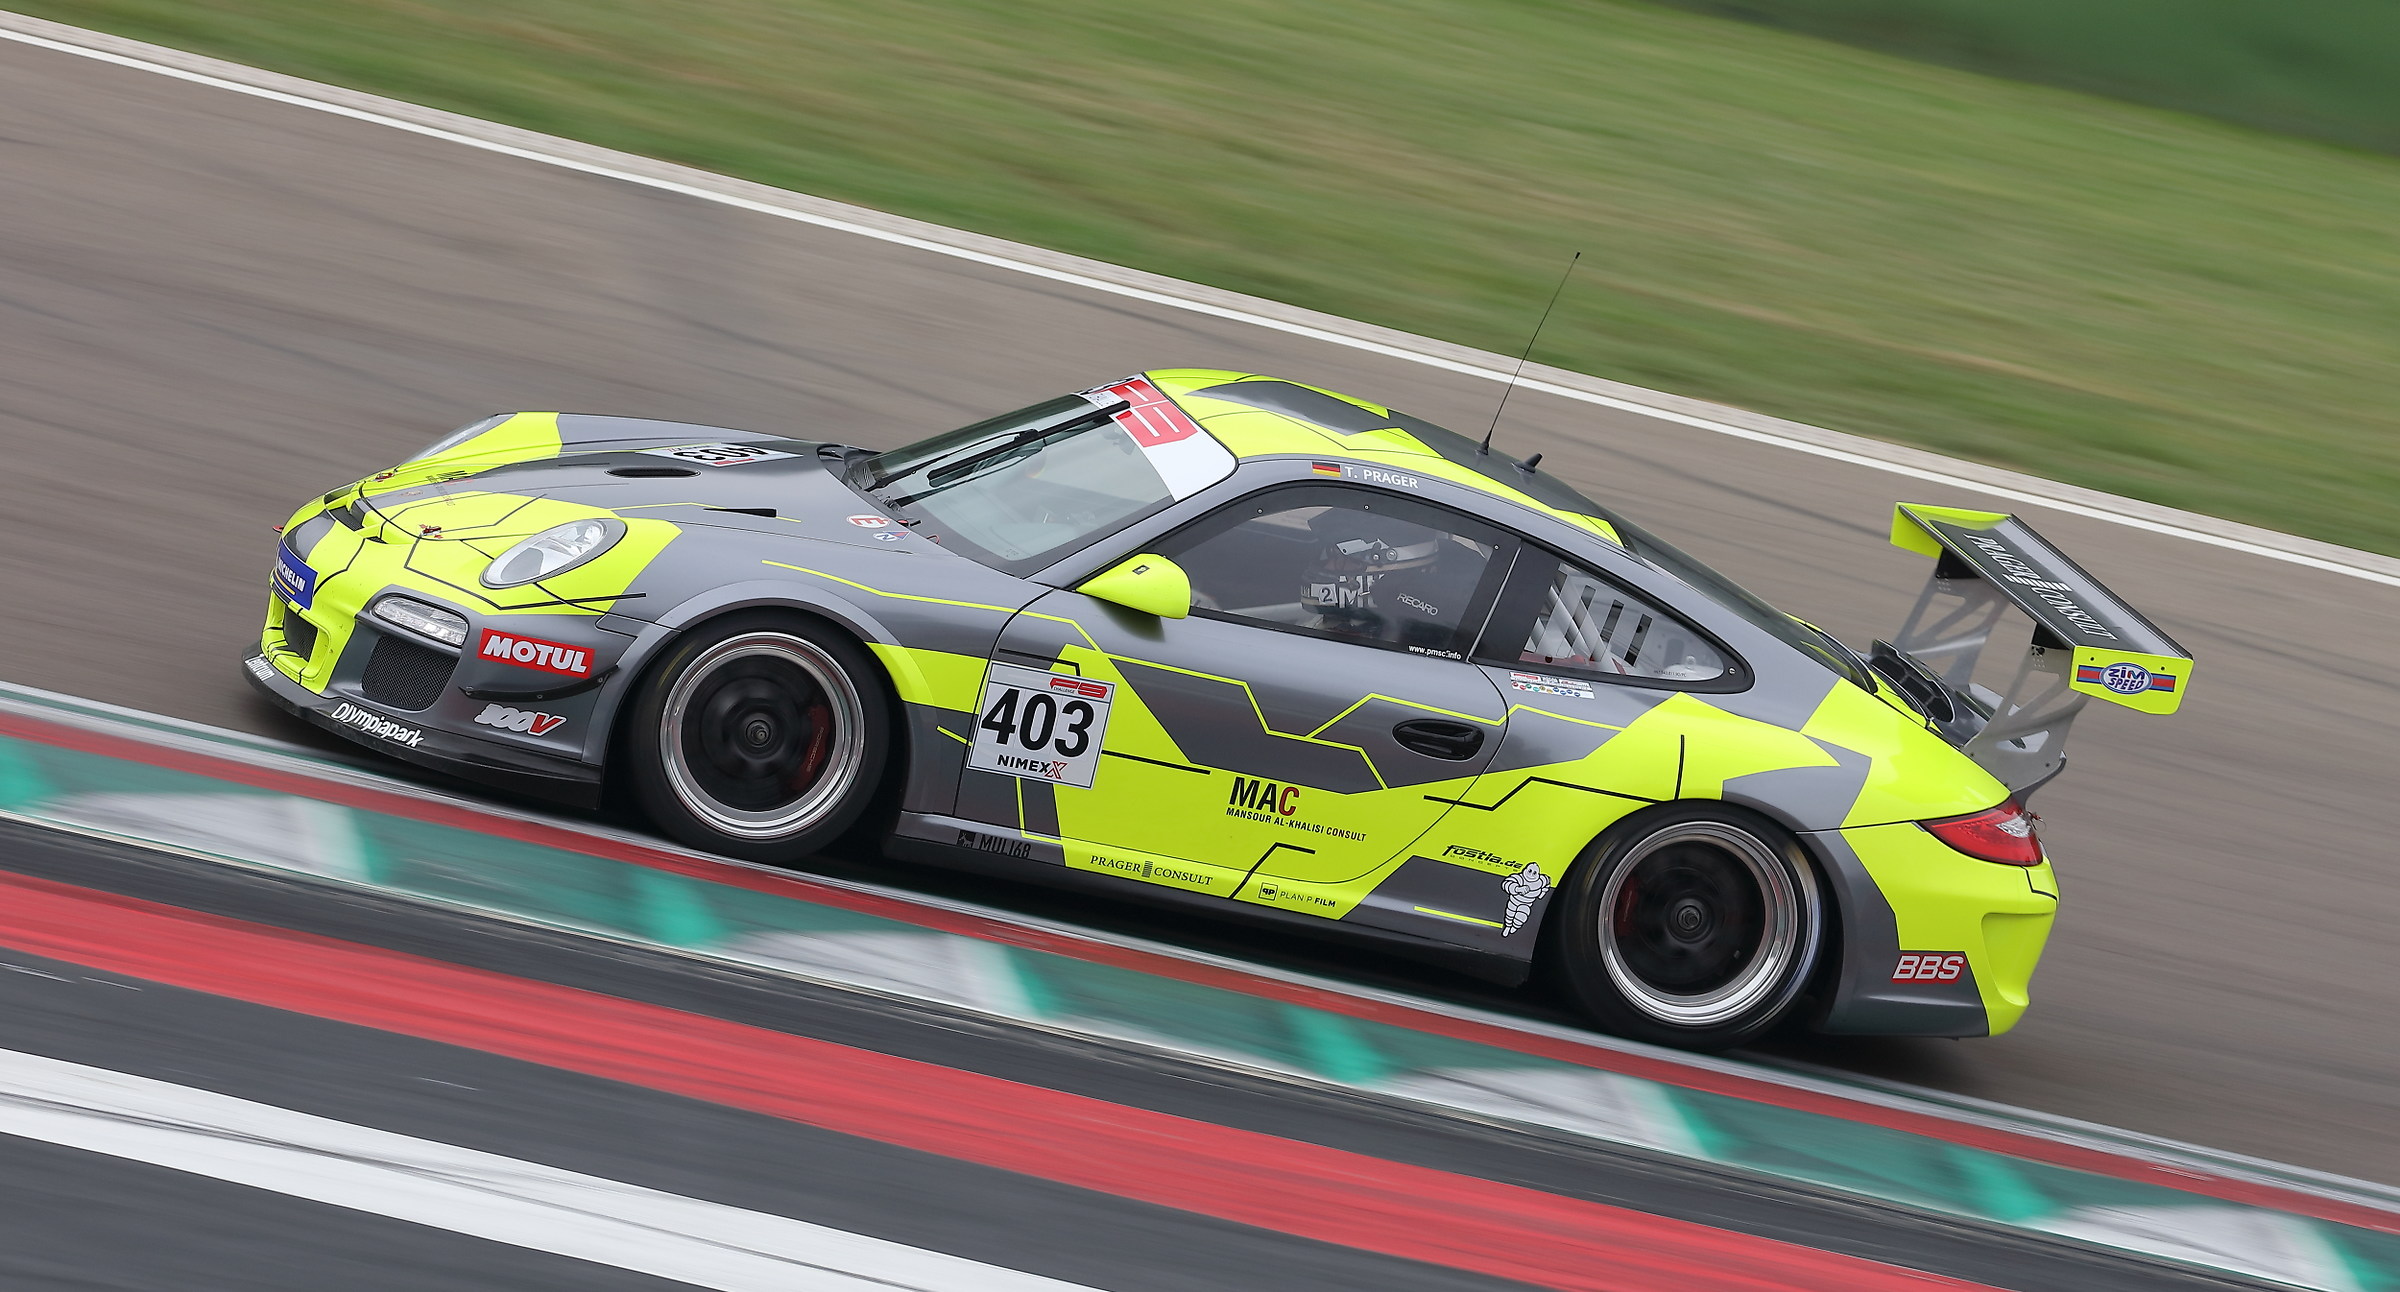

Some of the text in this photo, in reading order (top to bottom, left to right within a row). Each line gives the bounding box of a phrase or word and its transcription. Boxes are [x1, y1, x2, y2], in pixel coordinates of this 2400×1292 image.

[1345, 466, 1419, 489] T. PRAGER
[1320, 588, 1333, 602] 2
[1963, 533, 2119, 641] PRAGER CONSULT
[1396, 592, 1439, 616] RECARO
[482, 634, 588, 674] MOTUL
[2107, 677, 2145, 692] SPEED
[330, 702, 425, 748] Olympiapark
[980, 687, 1095, 758] 403
[1229, 776, 1300, 817] MAC
[1226, 807, 1367, 842] MANSOUR AL-KHALISI CONSULT
[1090, 855, 1214, 886] PRAGER CONSULT
[1280, 891, 1304, 902] PLAN
[1314, 897, 1336, 908] FILM
[1892, 954, 1965, 981] BBS
